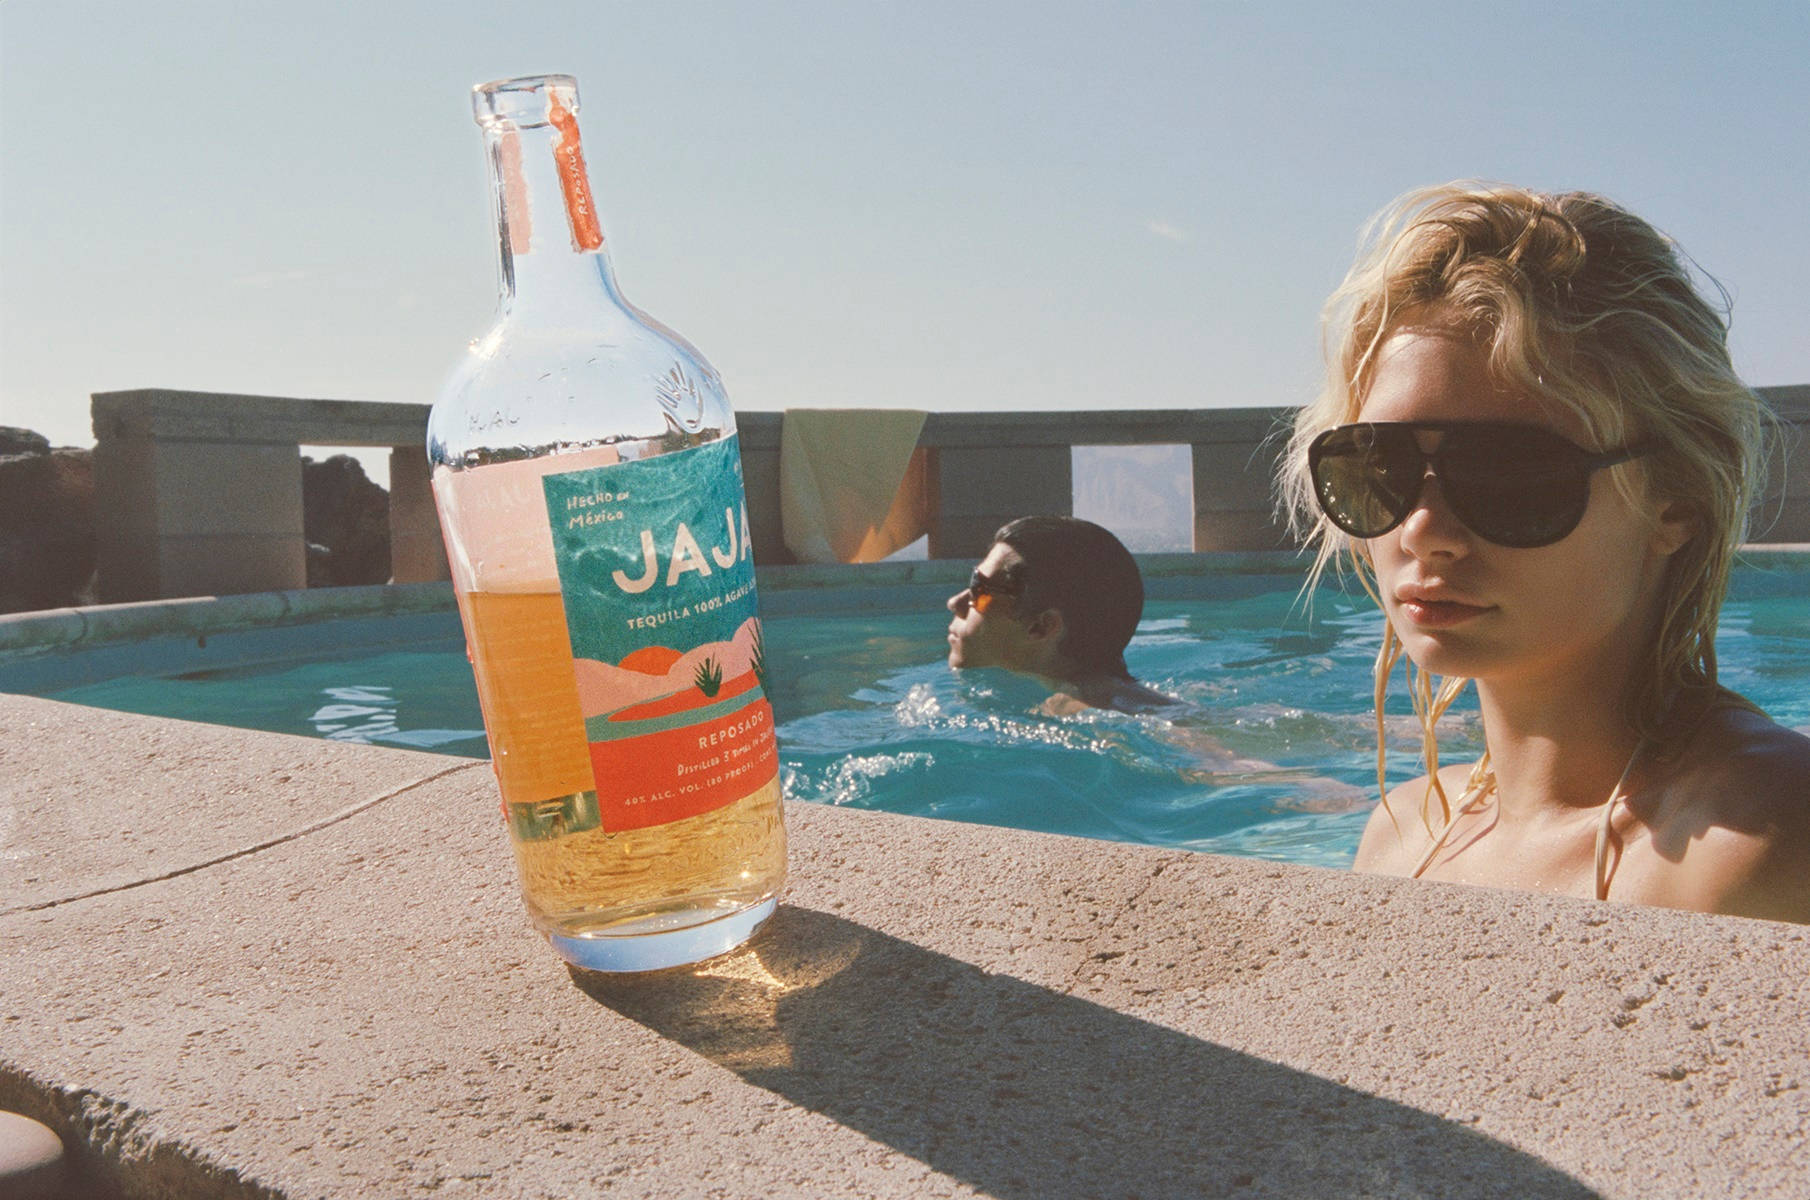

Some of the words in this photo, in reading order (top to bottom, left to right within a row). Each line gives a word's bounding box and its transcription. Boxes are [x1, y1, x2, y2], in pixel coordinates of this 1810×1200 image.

[567, 492, 613, 510] HECHO
[569, 511, 623, 529] México
[627, 607, 691, 630] TEQUILA
[694, 597, 723, 613] 100%
[724, 586, 749, 604] AGAVE
[698, 711, 765, 750] REPOSADO
[723, 751, 729, 763] 3
[624, 795, 646, 806] 40%
[650, 790, 676, 802] ALC.
